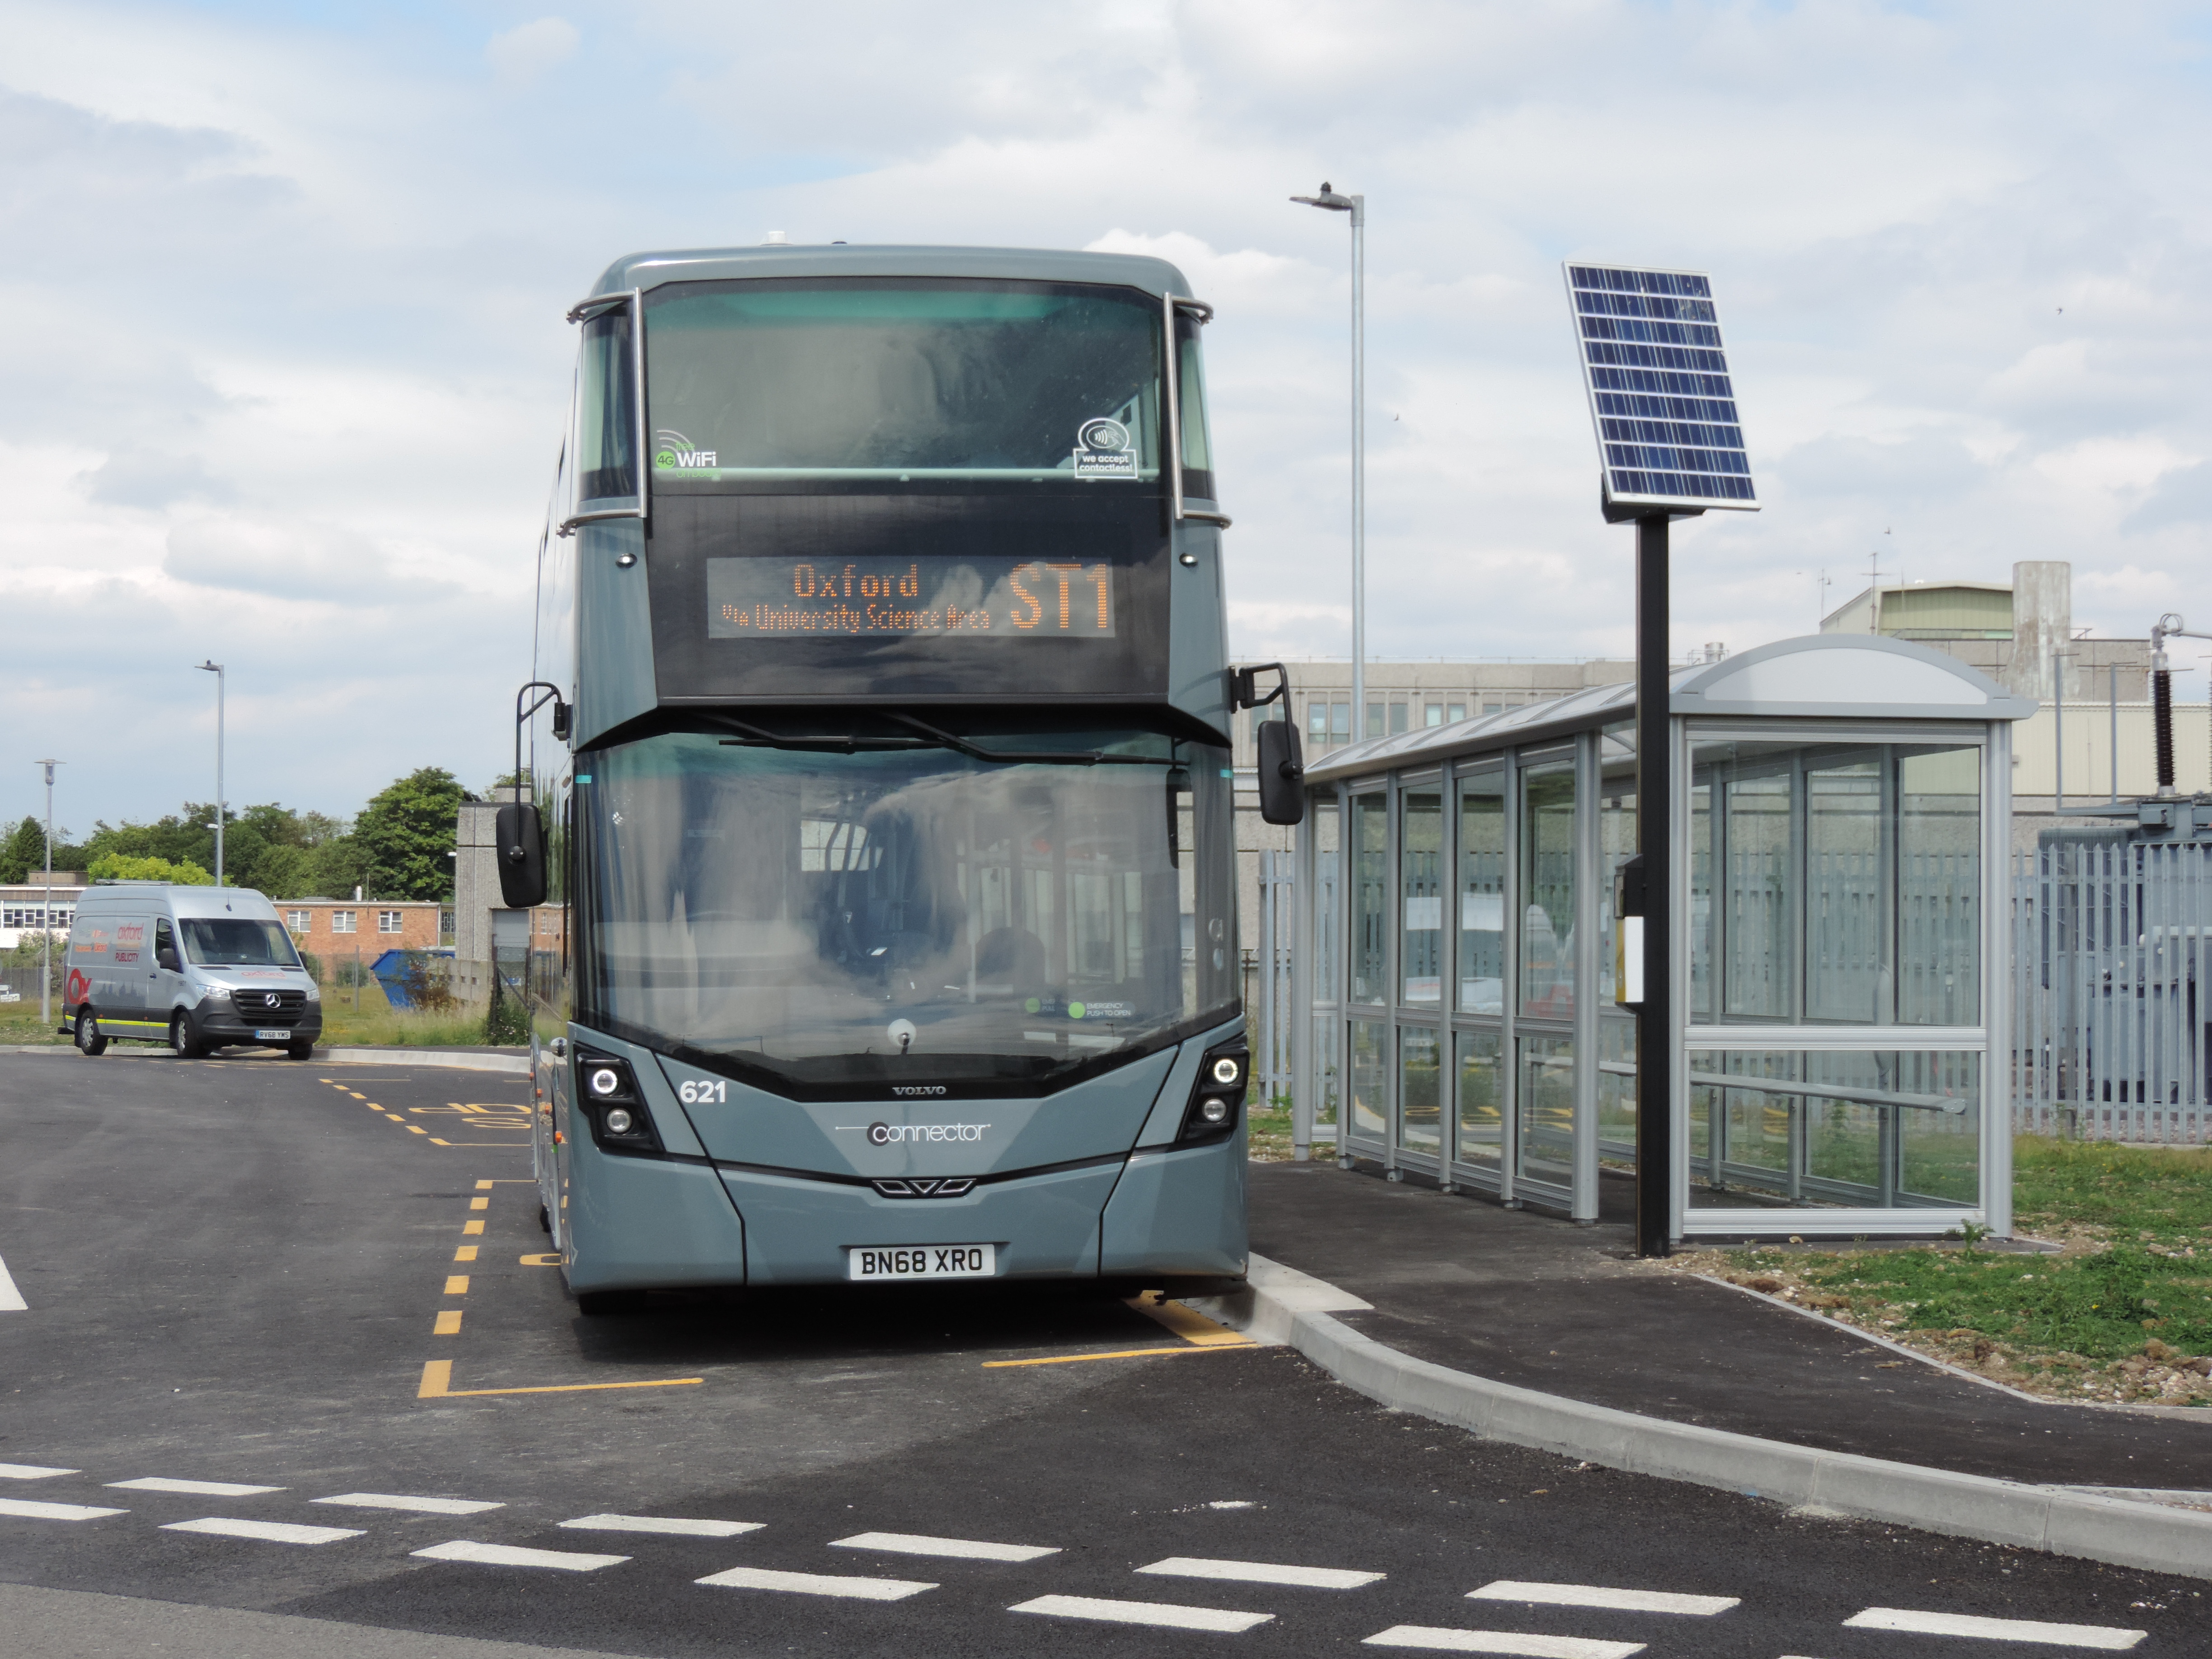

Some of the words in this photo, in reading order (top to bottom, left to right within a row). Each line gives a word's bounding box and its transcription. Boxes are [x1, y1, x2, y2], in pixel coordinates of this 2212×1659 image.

[657, 455, 674, 465] 4G
[677, 452, 717, 467] WiFi
[1079, 464, 1133, 472] contactless!
[1098, 455, 1129, 464] accept
[794, 563, 919, 597] Oxford
[1010, 563, 1107, 629] ST1
[756, 604, 860, 633] University
[867, 603, 939, 629] Science
[947, 604, 989, 629] Area
[115, 952, 140, 962] PUBLICITY
[680, 1081, 726, 1103] 621
[892, 1086, 947, 1095] VOLVO
[873, 1123, 986, 1143] connector
[862, 1250, 926, 1275] BN68
[935, 1248, 982, 1272] XRO
